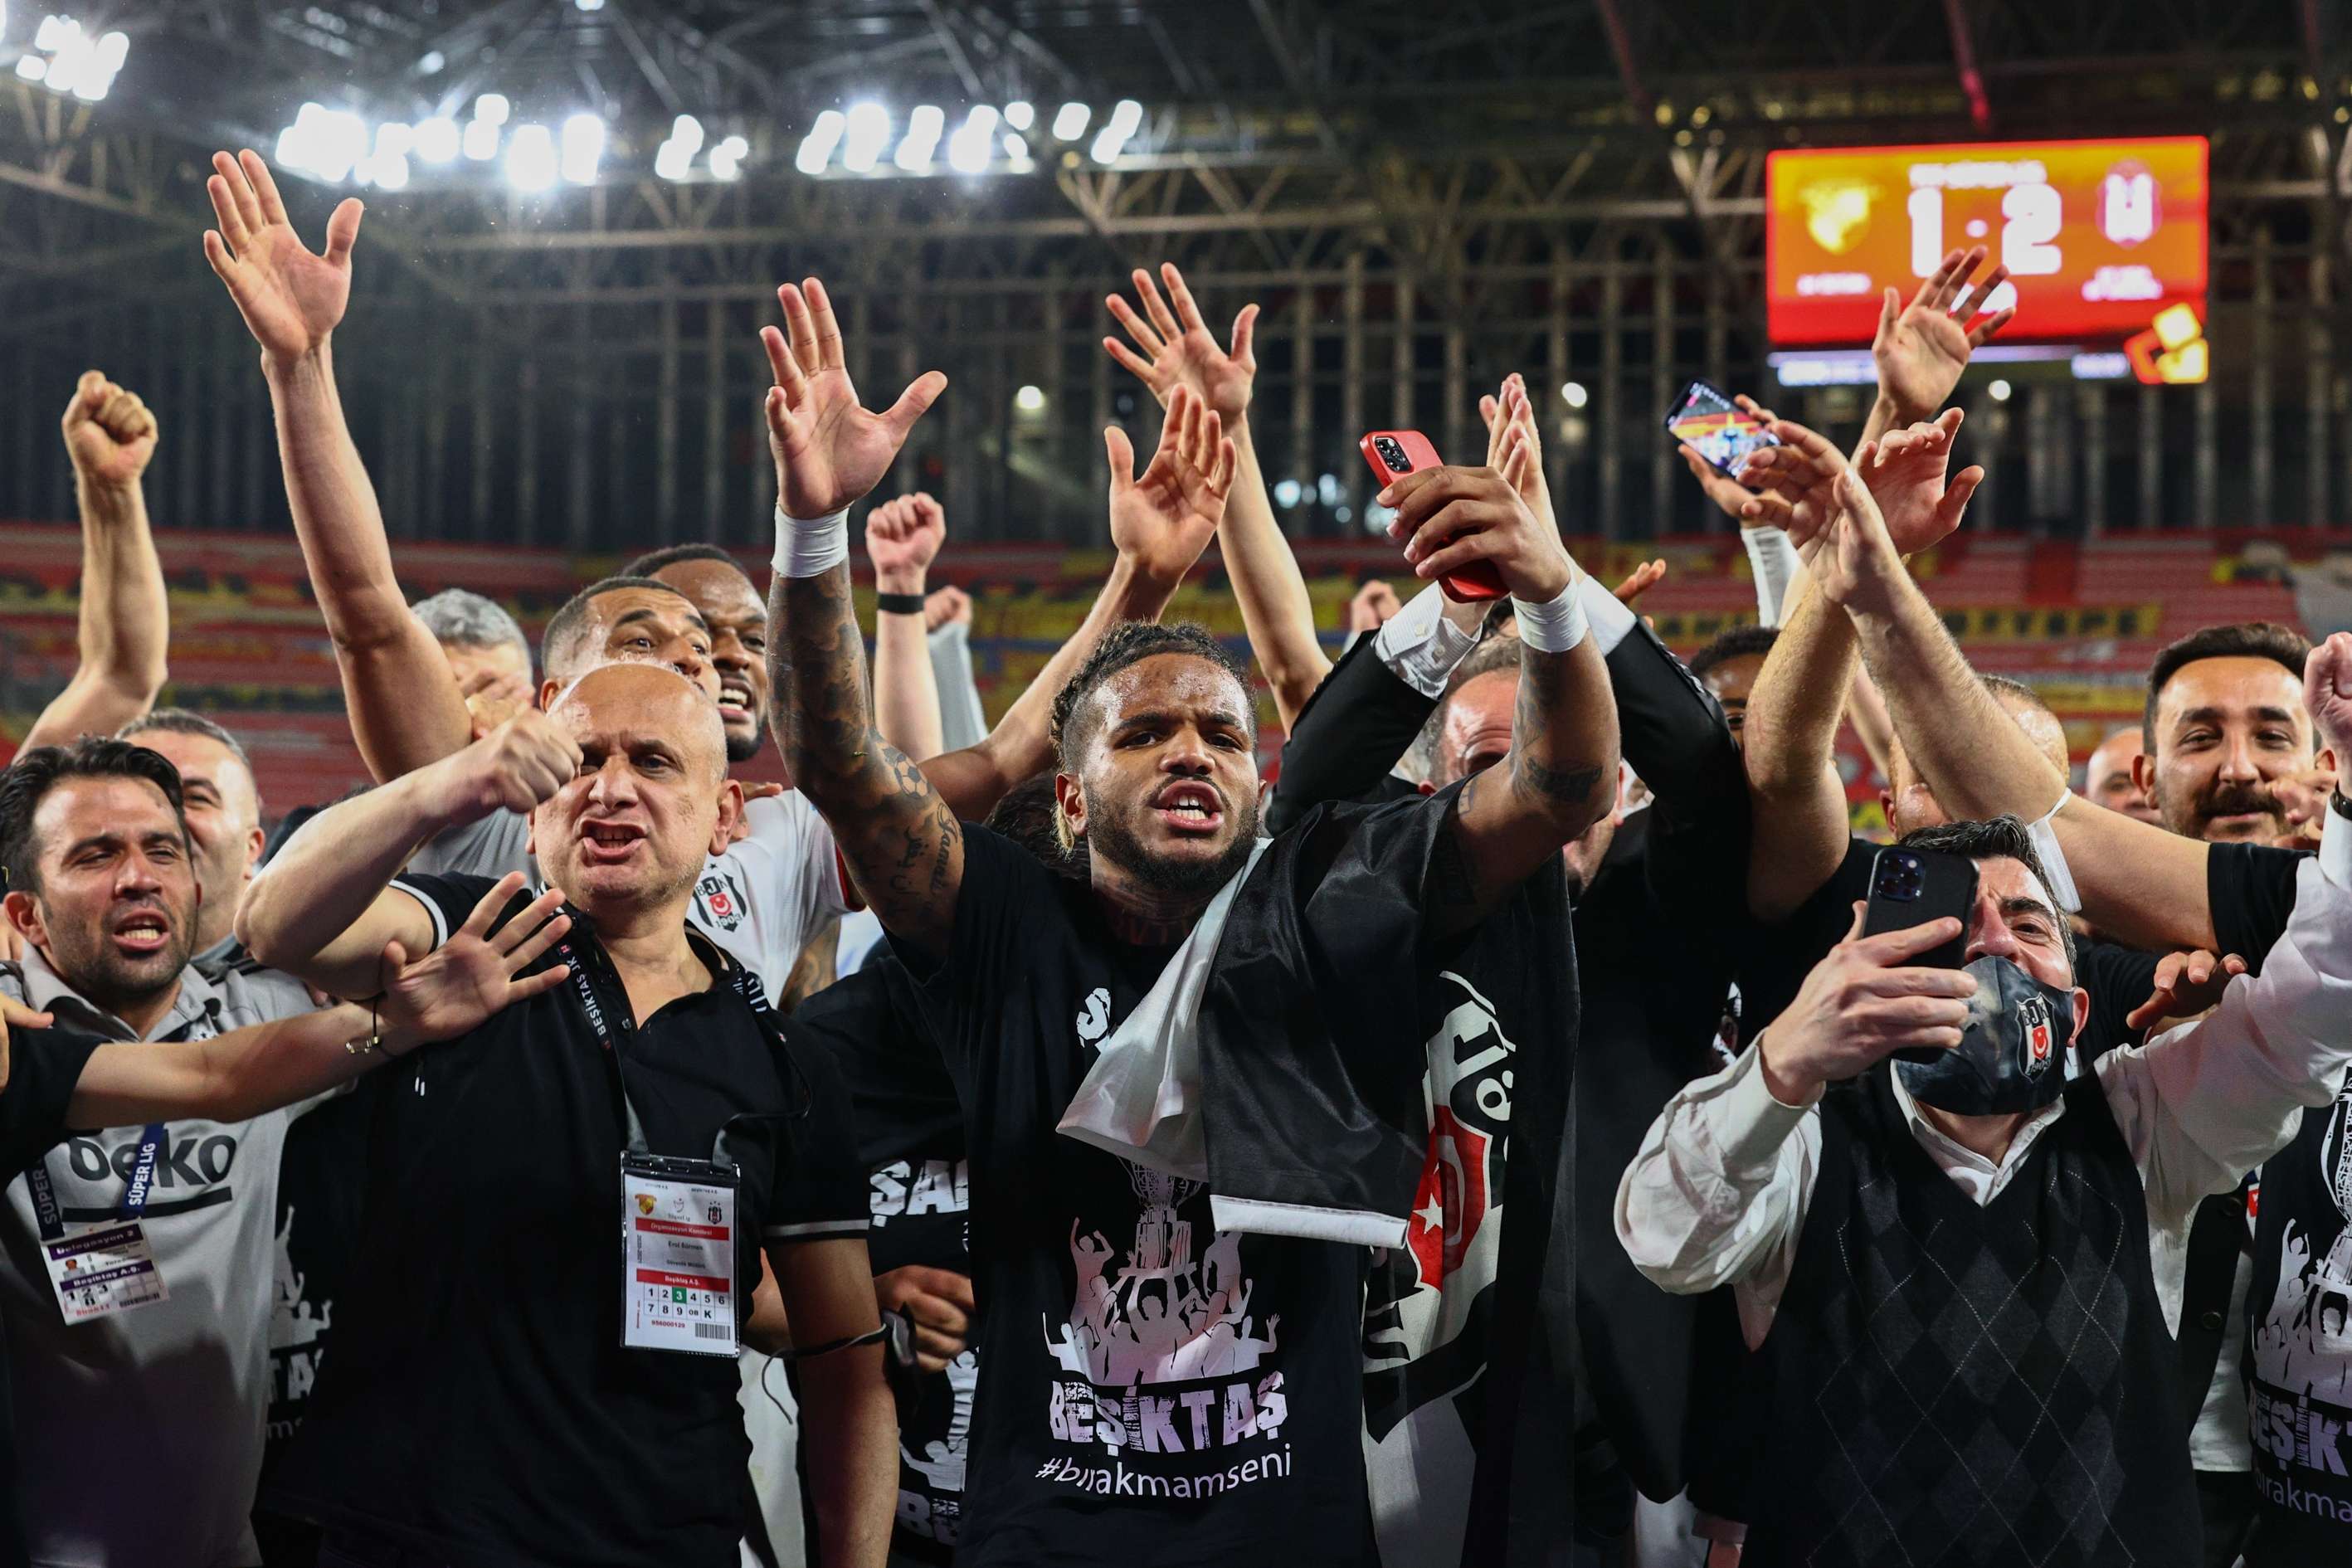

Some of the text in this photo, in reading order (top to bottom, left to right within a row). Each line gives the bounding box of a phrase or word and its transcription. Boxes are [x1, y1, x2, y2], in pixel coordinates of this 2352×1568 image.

[1907, 187, 1943, 278] 1
[2002, 183, 2062, 275] 2
[695, 876, 728, 897] BJK
[714, 913, 743, 928] 1903
[649, 1288, 725, 1305] 1 2 3 4 5 6
[648, 1303, 655, 1312] 7
[662, 1305, 669, 1314] 8
[676, 1307, 684, 1316] 9
[704, 1310, 712, 1319] K
[1049, 1371, 1289, 1457] BEŞİKTAŞ
